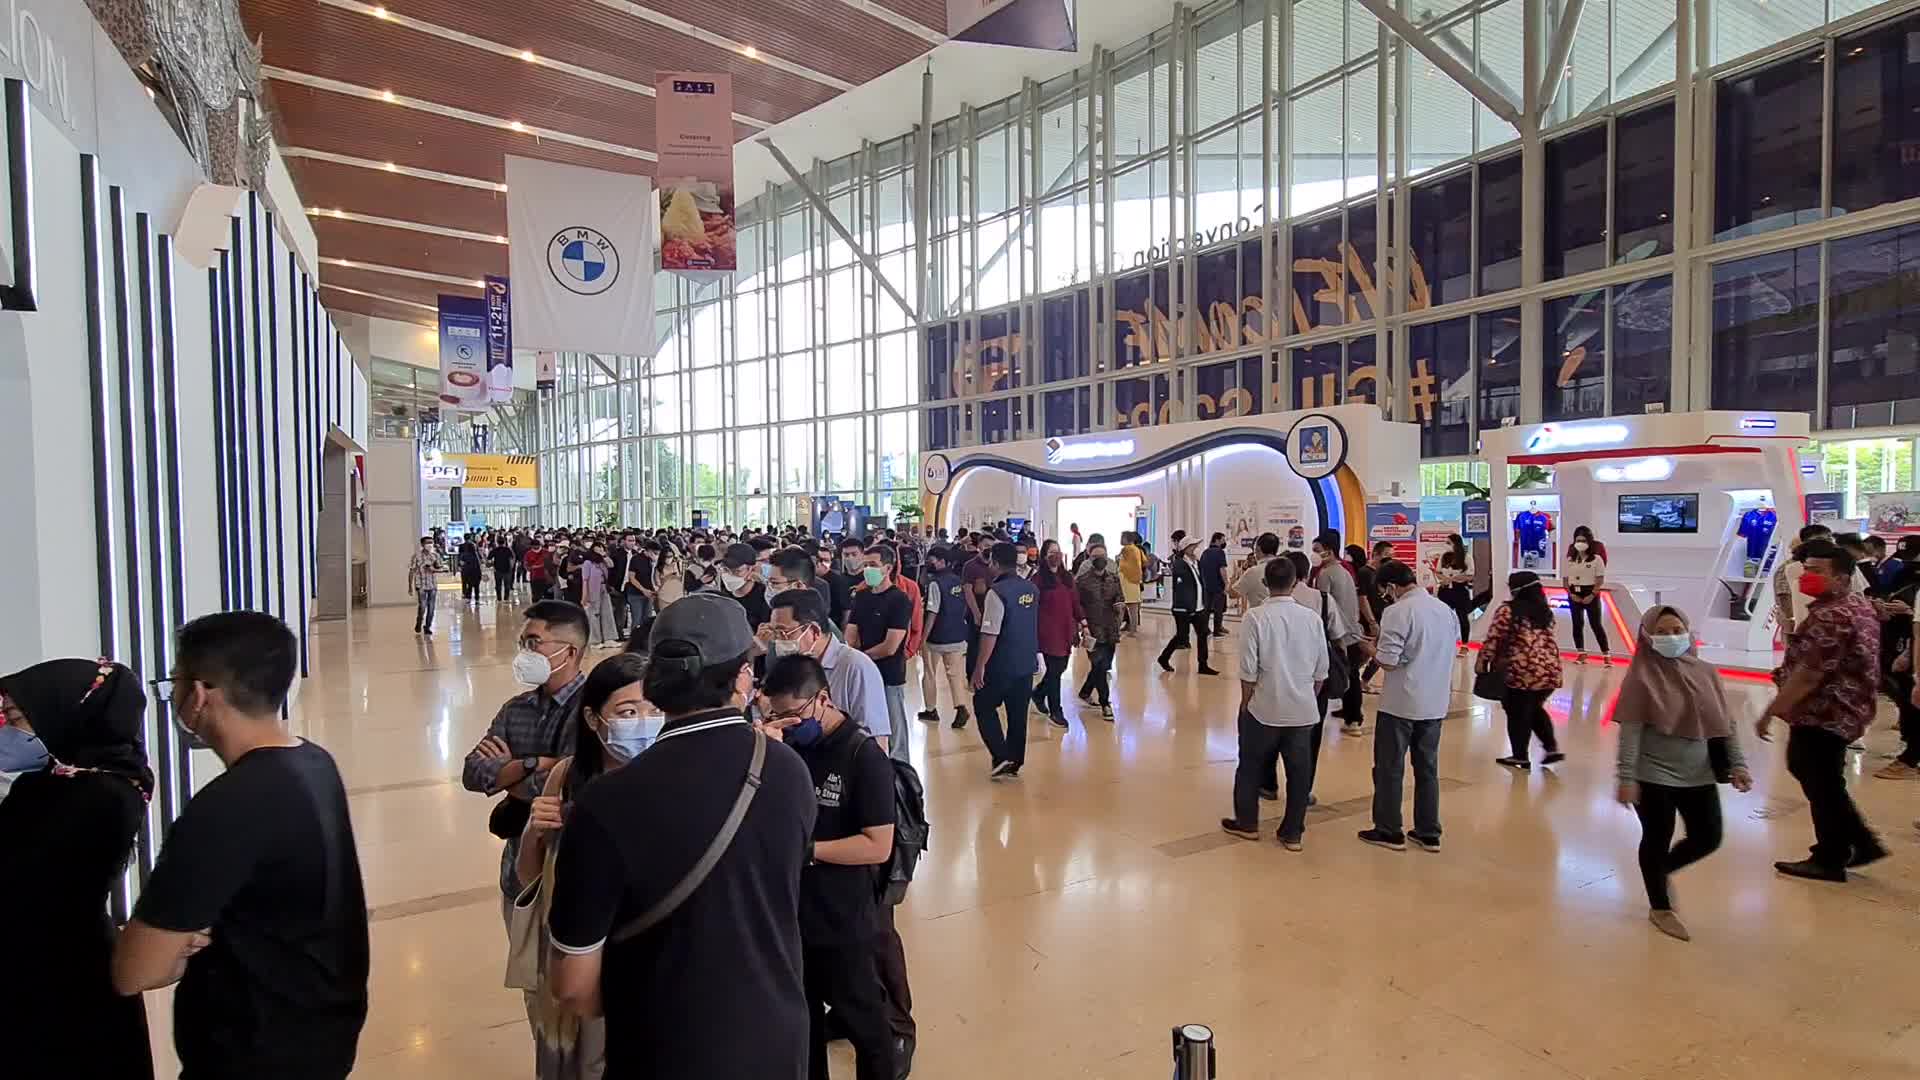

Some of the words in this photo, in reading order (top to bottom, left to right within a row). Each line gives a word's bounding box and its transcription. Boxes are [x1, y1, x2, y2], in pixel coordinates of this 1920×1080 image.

[0, 0, 80, 132] ION.
[557, 230, 609, 250] BMW
[432, 466, 459, 476] PF1
[496, 476, 518, 487] 5-8
